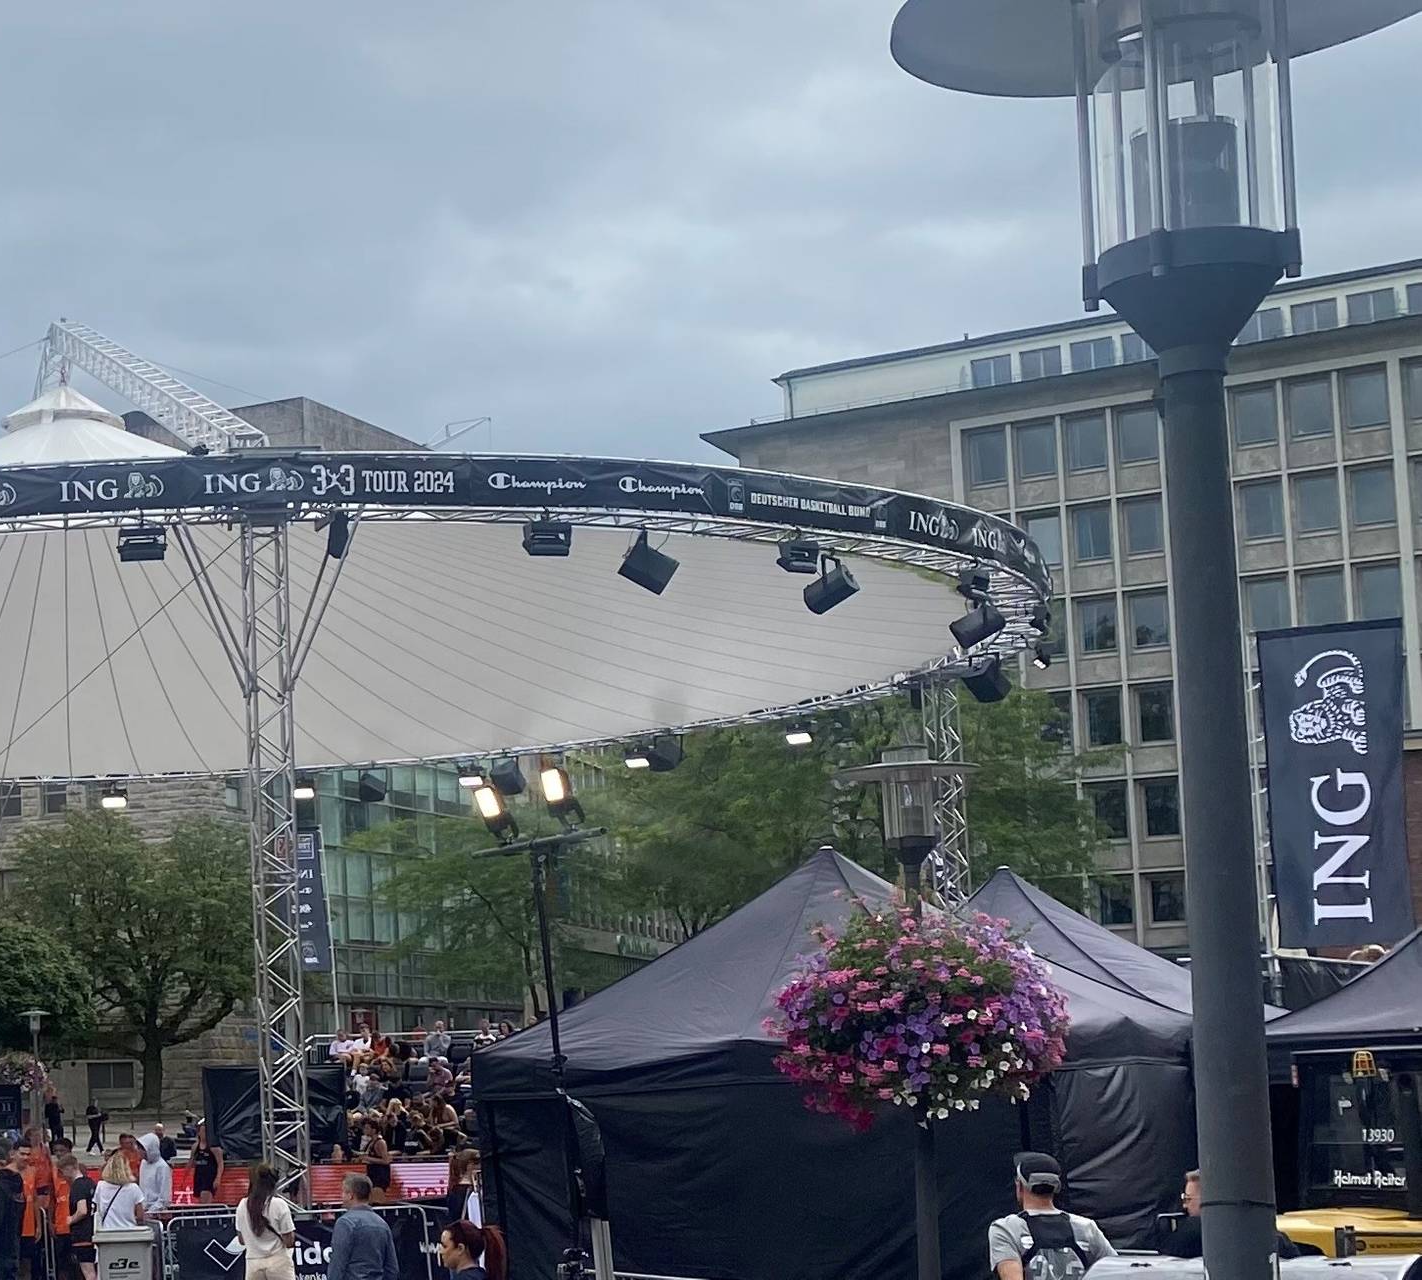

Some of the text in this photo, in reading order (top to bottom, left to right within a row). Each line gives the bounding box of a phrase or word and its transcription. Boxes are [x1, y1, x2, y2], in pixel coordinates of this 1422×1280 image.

[59, 479, 119, 503] ING
[203, 464, 455, 496] ING 3x3 TOUR 2024
[488, 472, 587, 495] Champion
[618, 476, 704, 500] Champion
[750, 492, 871, 518] DEUTSCHER BASKETBALL BUND
[908, 510, 941, 536] ING
[973, 527, 999, 550] ING
[1310, 767, 1373, 926] ING
[1362, 1128, 1395, 1143] 13930
[1334, 1169, 1407, 1189] Helmut Reiter
